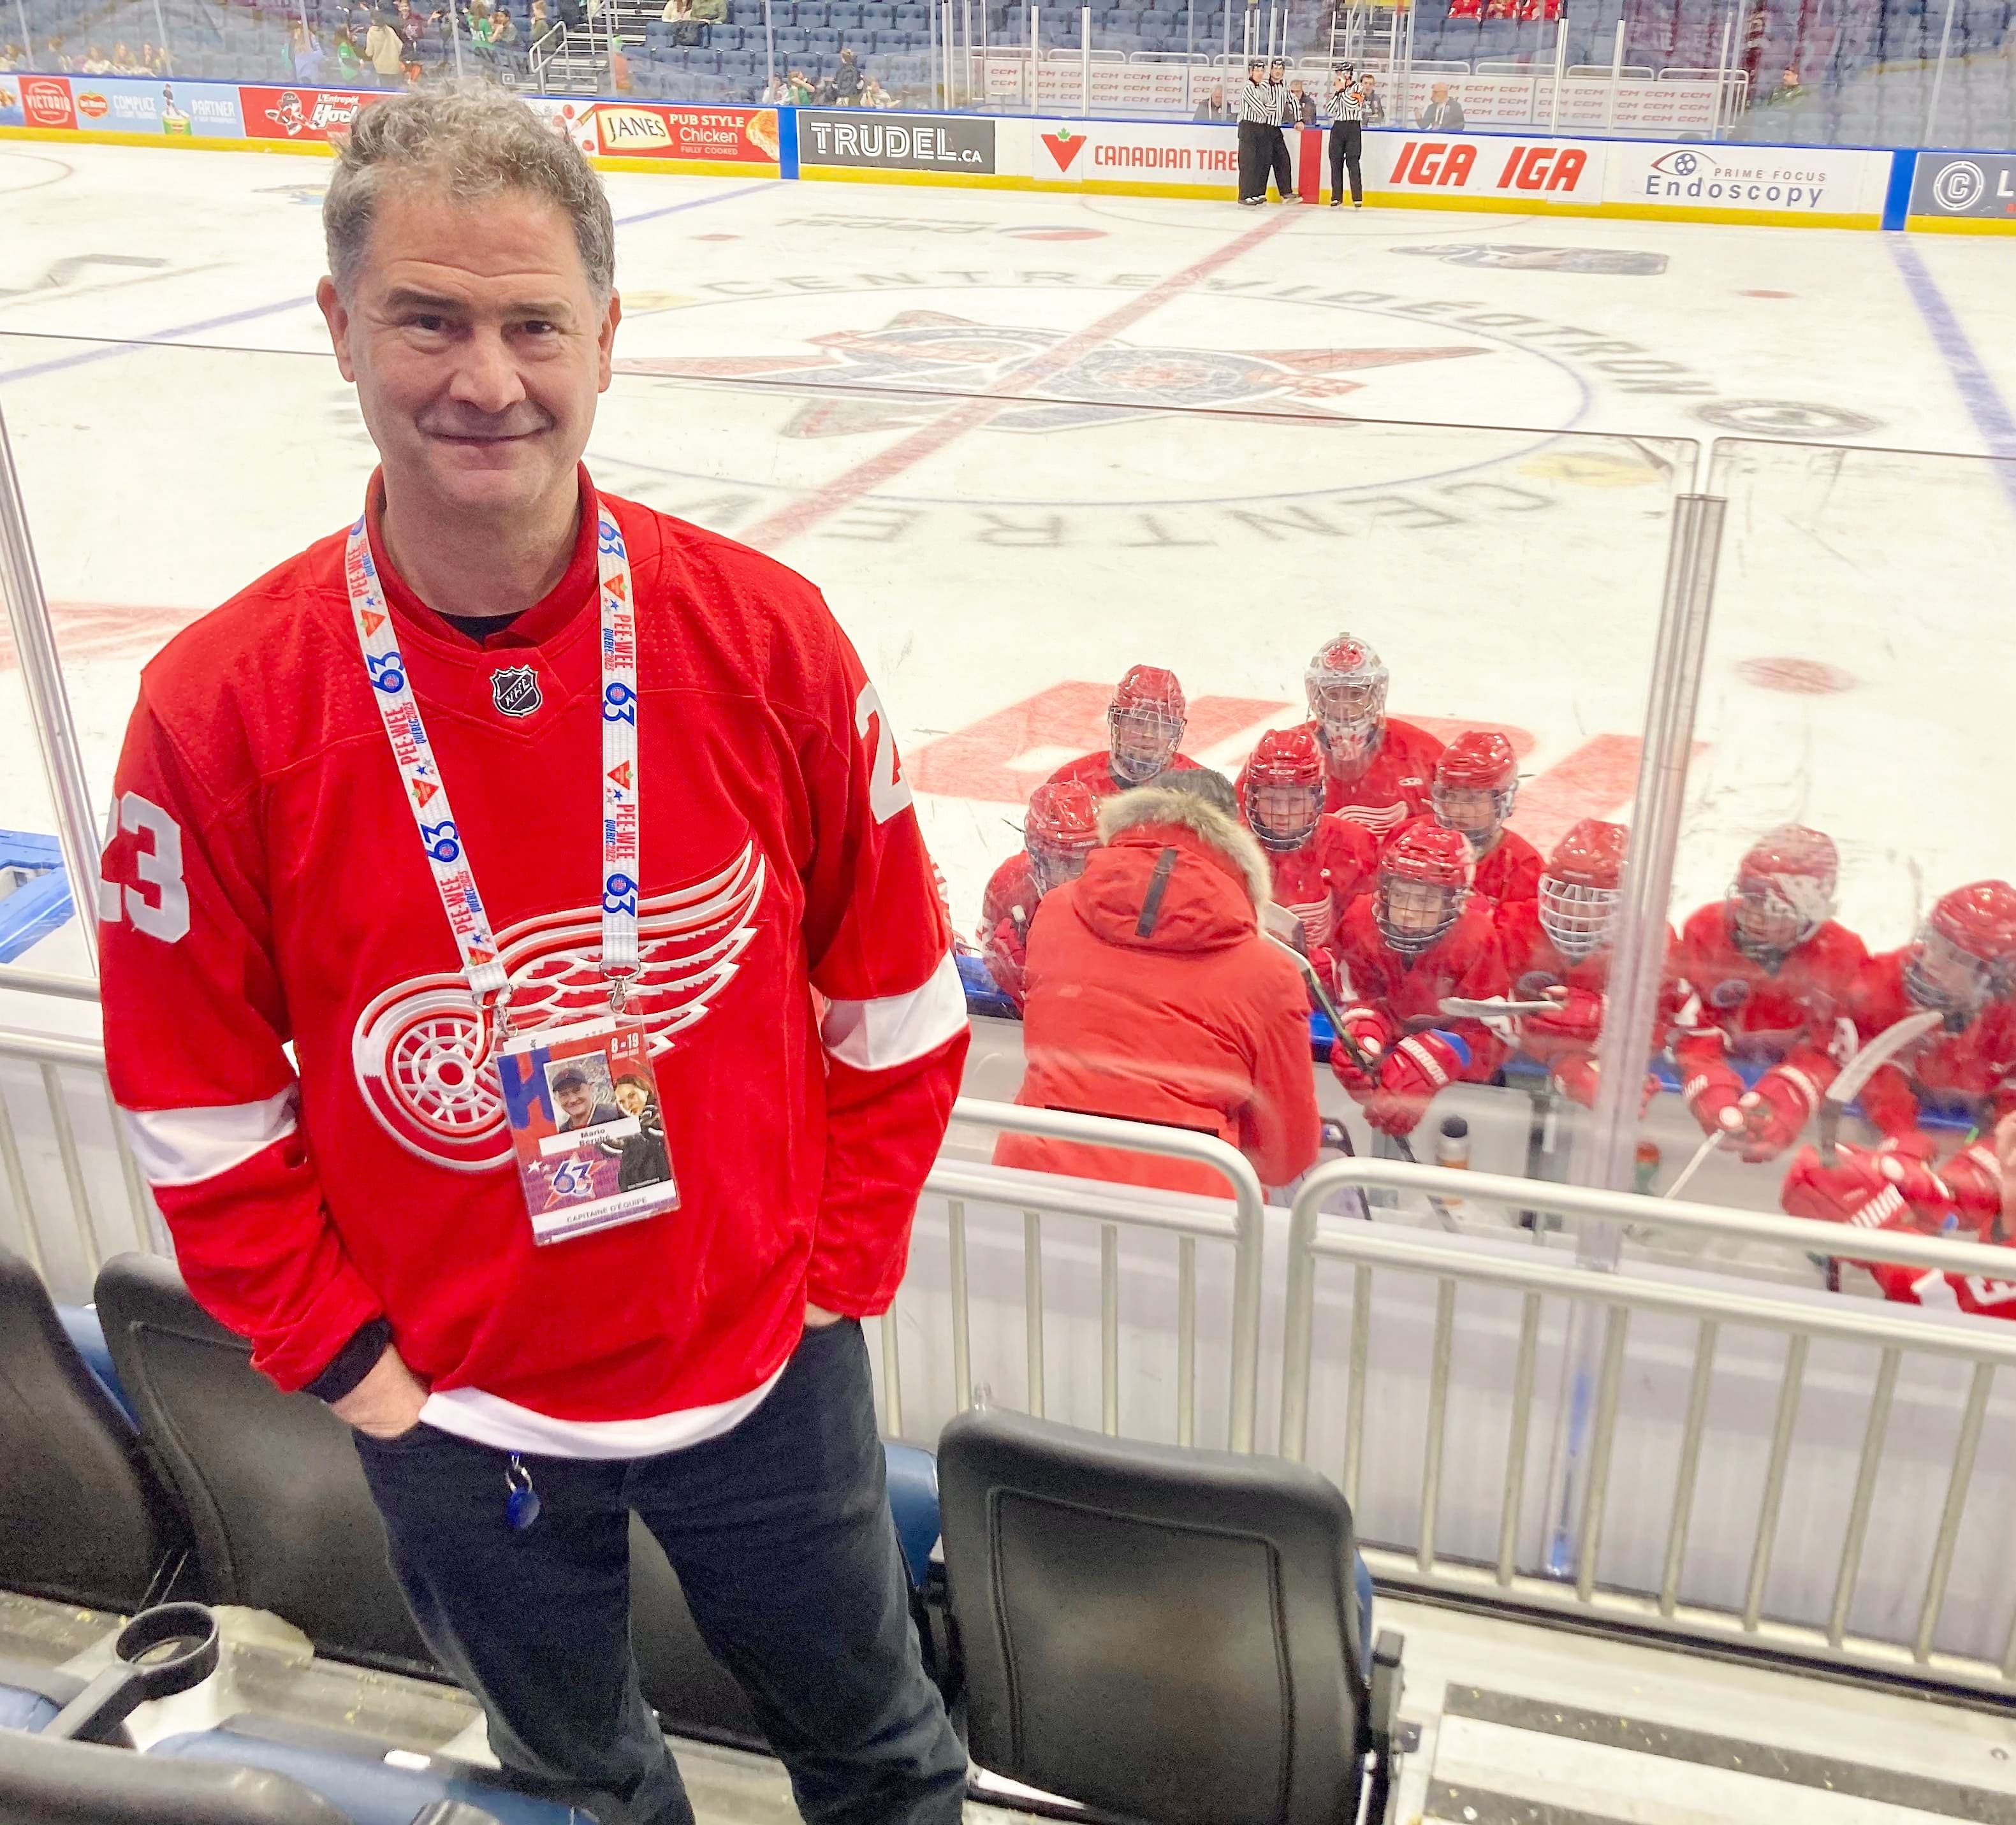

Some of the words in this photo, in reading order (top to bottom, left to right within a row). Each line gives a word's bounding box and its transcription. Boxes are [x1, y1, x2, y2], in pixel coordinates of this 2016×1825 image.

[26, 94, 71, 113] VICTORIA
[113, 96, 156, 112] COMPLICE
[192, 99, 235, 117] PARTNER
[317, 93, 360, 104] L'Entrepôt
[608, 117, 667, 143] JANES
[669, 113, 699, 126] PUB
[701, 115, 745, 128] STYLE
[679, 127, 739, 143] Chicken
[681, 145, 702, 154] FULLY
[704, 146, 738, 156] COOKED
[1094, 145, 1191, 170] CANADIAN
[1196, 149, 1238, 171] TIRE
[1389, 142, 1478, 186] IGA
[1496, 146, 1588, 191] IGA
[1714, 167, 1764, 180] PRIME
[1773, 170, 1827, 182] FOCUS
[1646, 175, 1824, 208] Endoscopy
[702, 270, 1162, 296] CENTRE
[817, 482, 1559, 549] CENTRE
[599, 520, 626, 561] 63
[347, 547, 369, 597] PEE-WEE
[614, 614, 636, 669] PEE-WEE
[367, 650, 405, 694] 63
[504, 679, 531, 707] NHL
[603, 682, 638, 727] 63
[385, 702, 420, 766] PEE-WEE
[420, 820, 460, 862] 63
[616, 804, 636, 860] PEE-WEE
[440, 875, 474, 934] PEE-WEE
[603, 873, 638, 918] 63
[581, 1128, 605, 1138] Mario
[553, 1160, 594, 1195] 63
[567, 1206, 608, 1223] CAPITAINE
